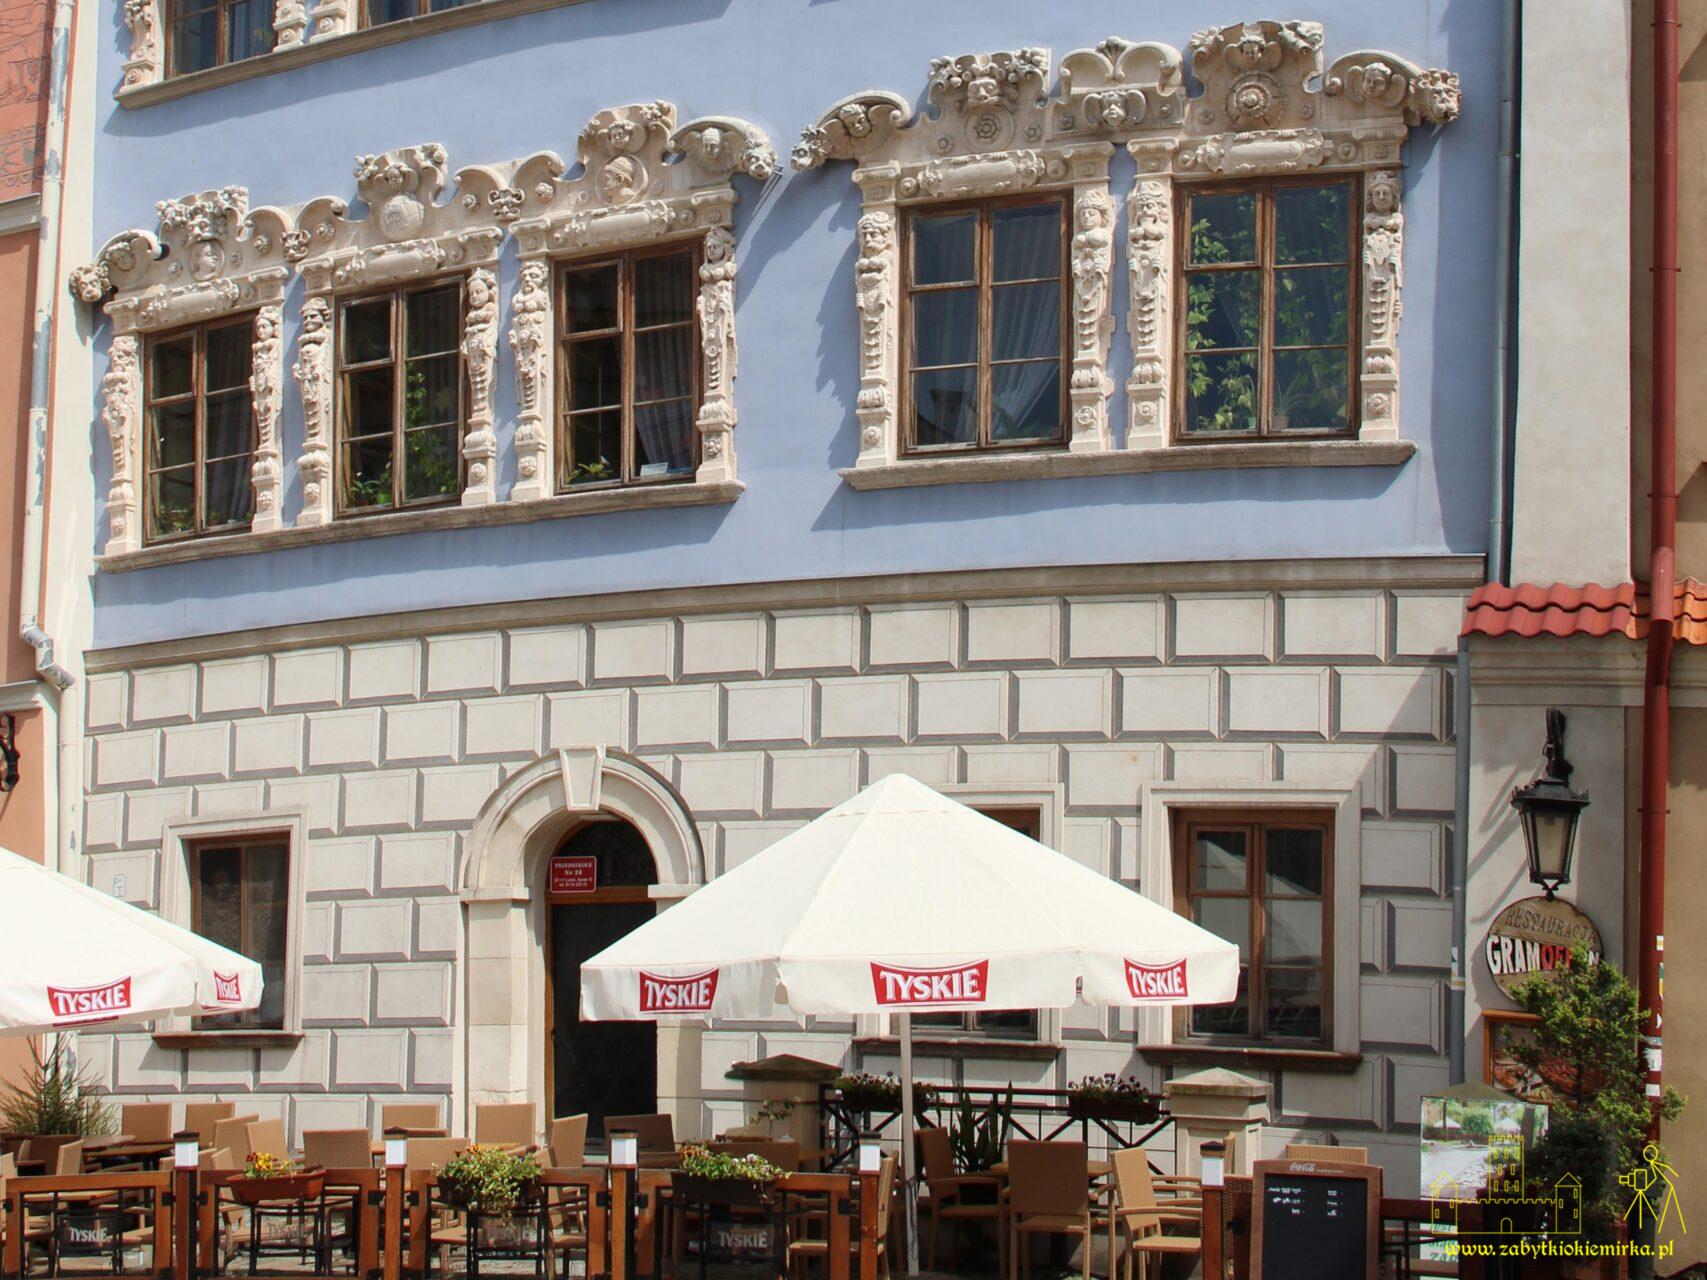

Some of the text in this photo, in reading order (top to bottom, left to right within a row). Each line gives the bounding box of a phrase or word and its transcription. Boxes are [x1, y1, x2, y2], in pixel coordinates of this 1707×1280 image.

[217, 976, 240, 999] TYSKIE
[644, 976, 713, 1010] TYSKIE
[879, 968, 981, 1002] TYSKIE
[1128, 965, 1186, 996] TYSKIE
[53, 984, 128, 1016] TYSKIE
[69, 1226, 109, 1243] TYSKIE
[718, 1230, 768, 1249] TYSKIE
